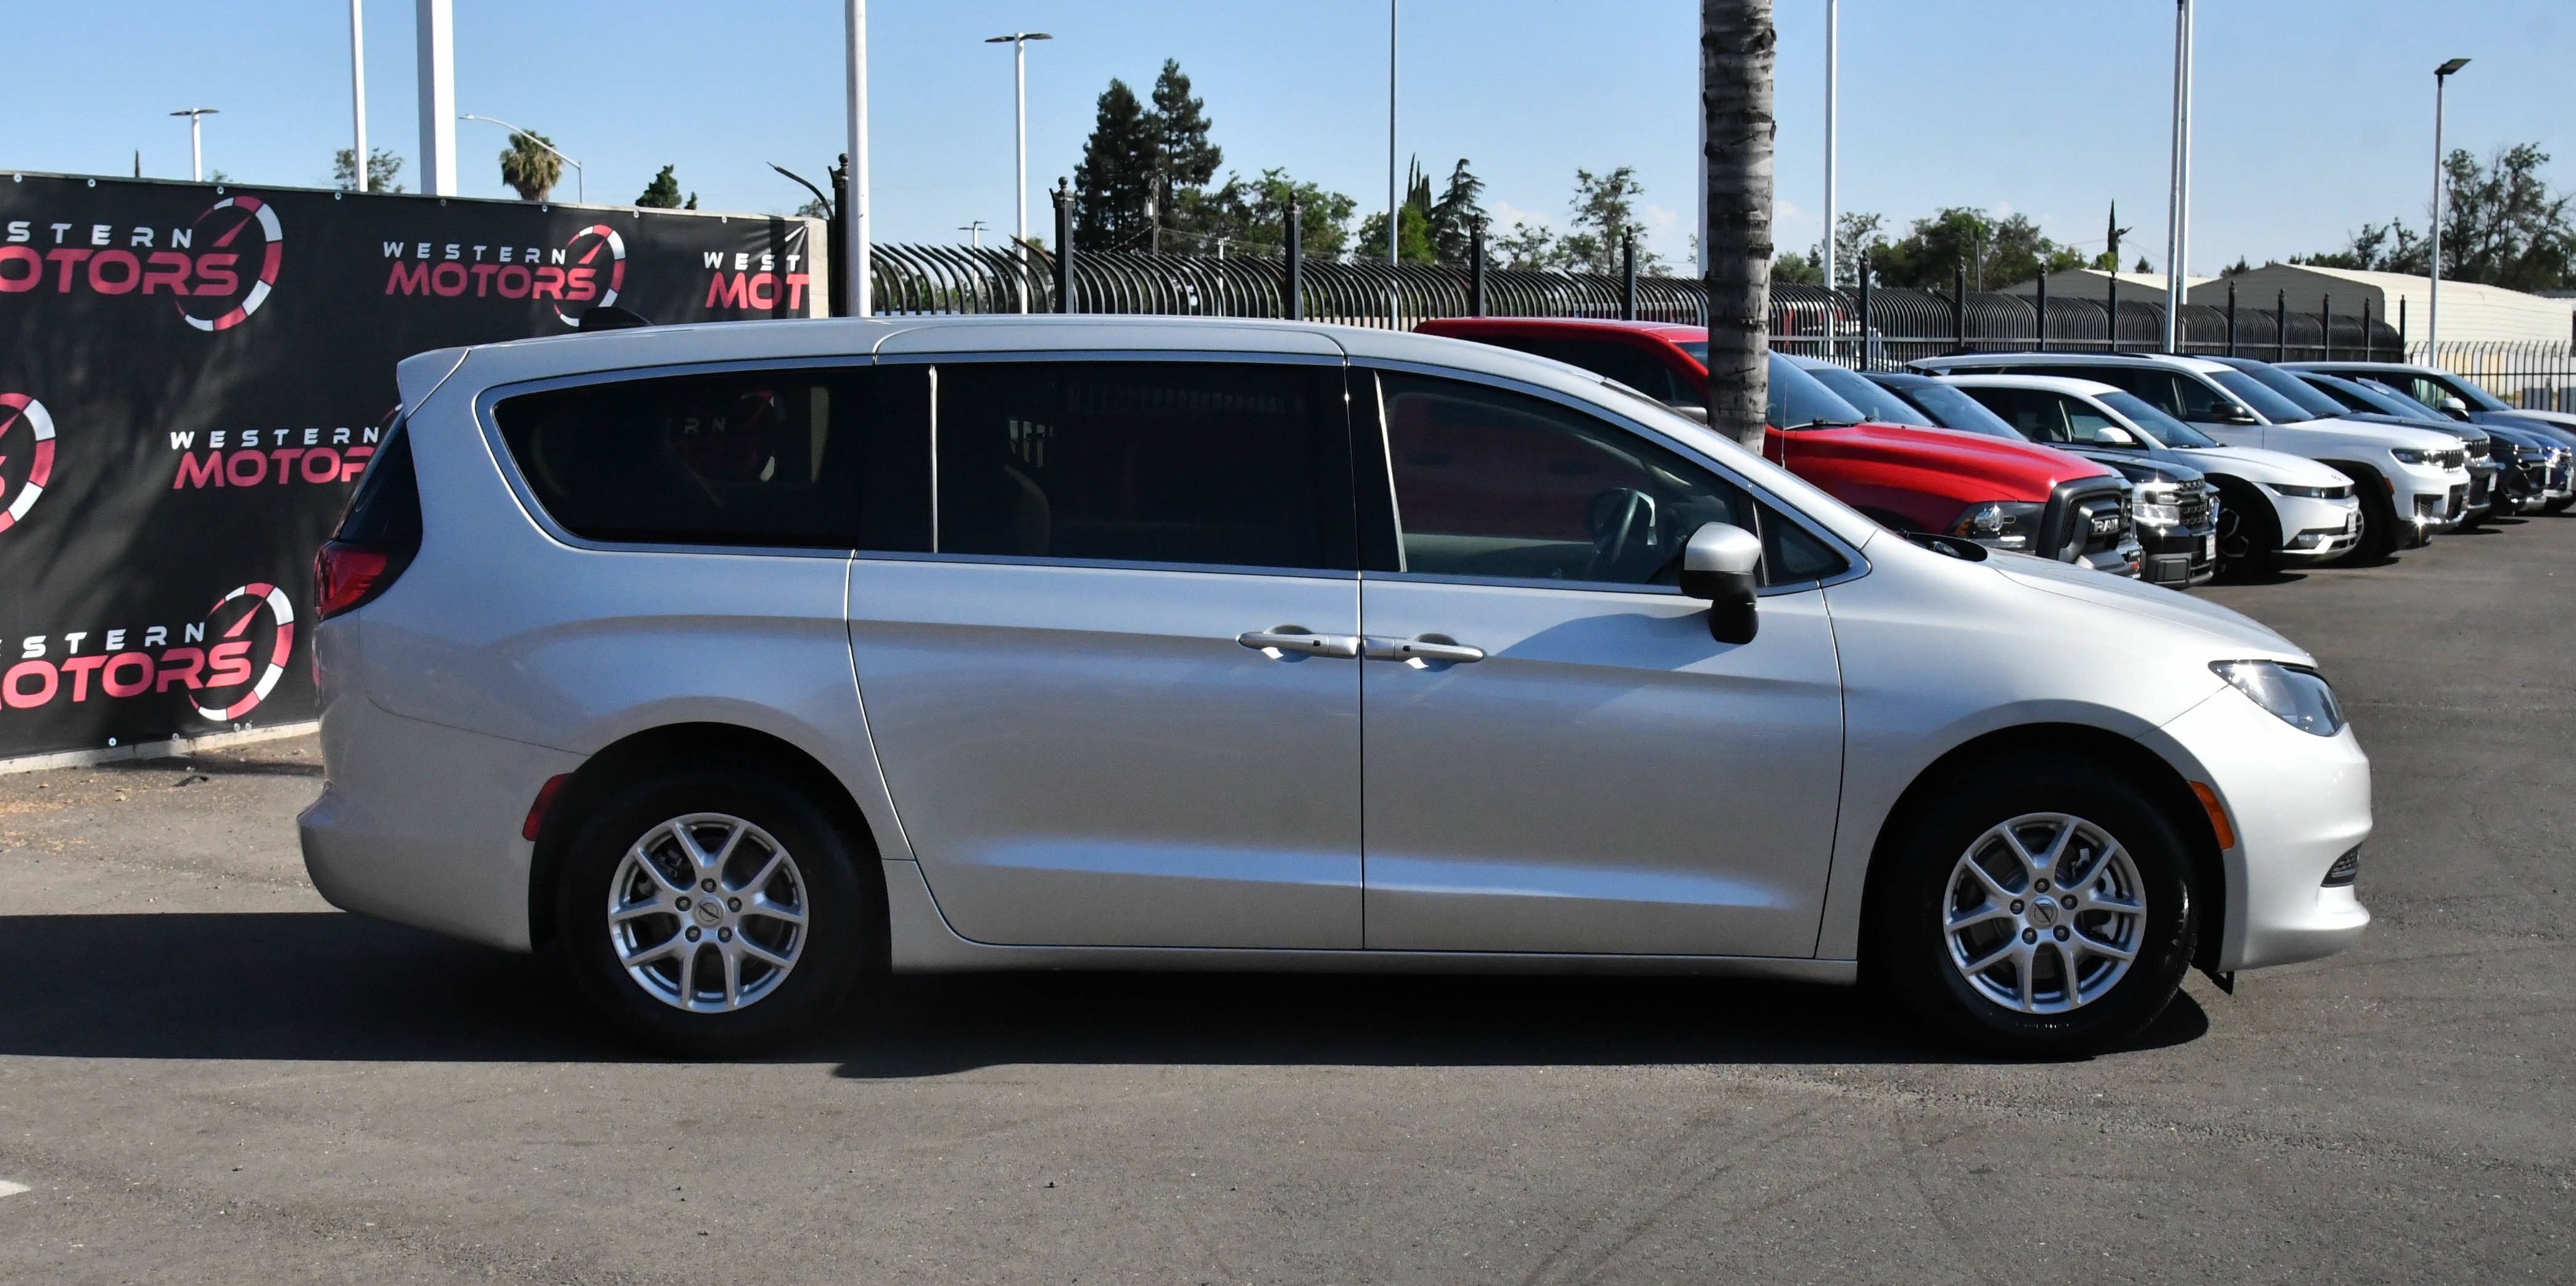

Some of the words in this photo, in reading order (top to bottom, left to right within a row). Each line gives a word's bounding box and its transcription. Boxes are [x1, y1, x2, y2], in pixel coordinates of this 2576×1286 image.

[384, 241, 566, 264] WESTERN
[703, 251, 801, 272] WEST
[386, 261, 597, 301] MOTORS
[705, 271, 811, 310] MOT
[170, 426, 379, 450] WESTERN
[0, 622, 205, 660] STERN
[0, 640, 253, 711] OTORS
